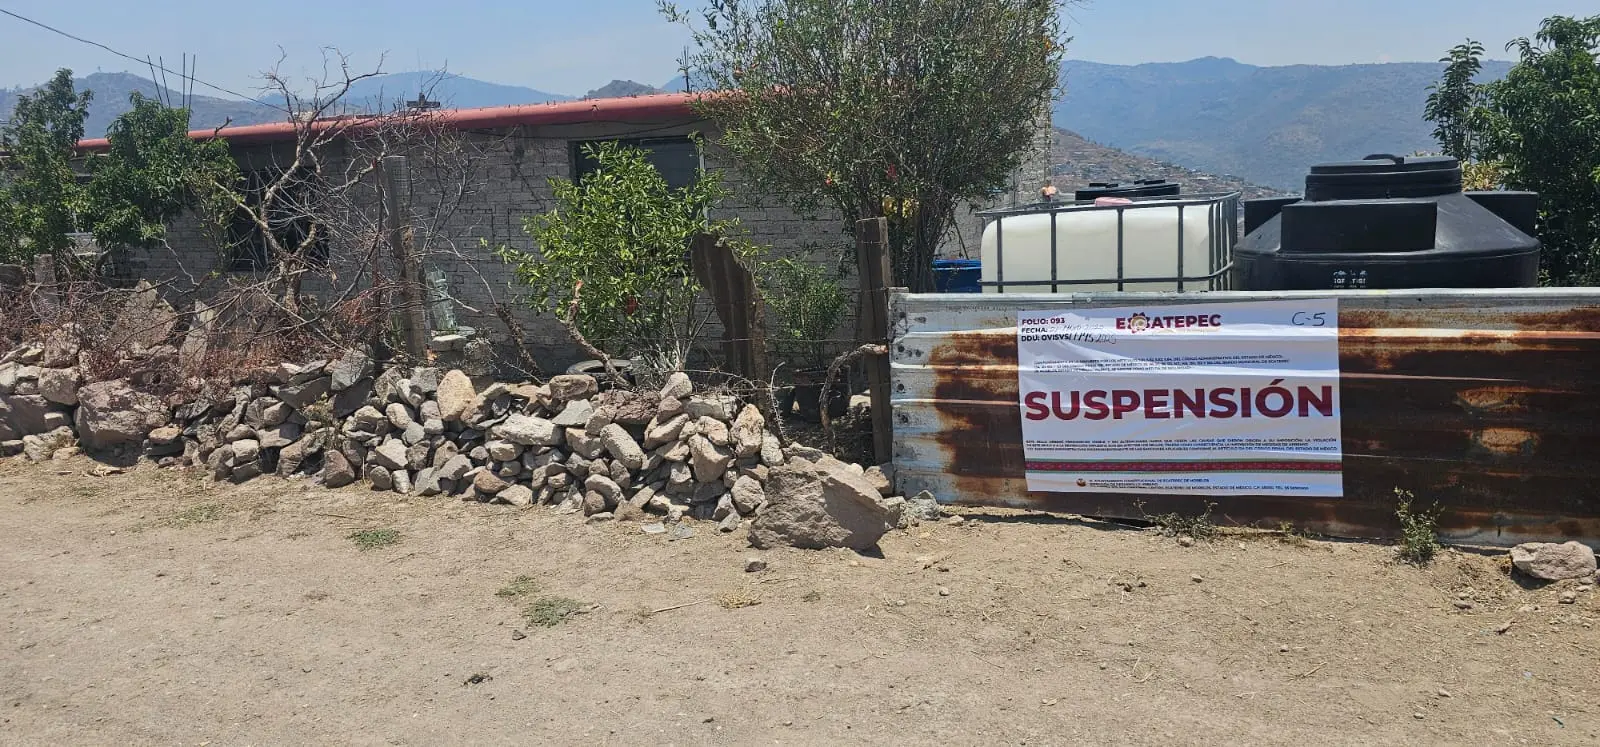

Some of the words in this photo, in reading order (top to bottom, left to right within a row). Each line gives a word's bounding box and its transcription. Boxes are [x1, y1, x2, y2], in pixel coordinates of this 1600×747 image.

[1050, 317, 1066, 325] 093
[1115, 313, 1222, 331] EATEPEC
[1291, 311, 1327, 327] C-5
[1024, 378, 1334, 421] SUSPENSIÓN
